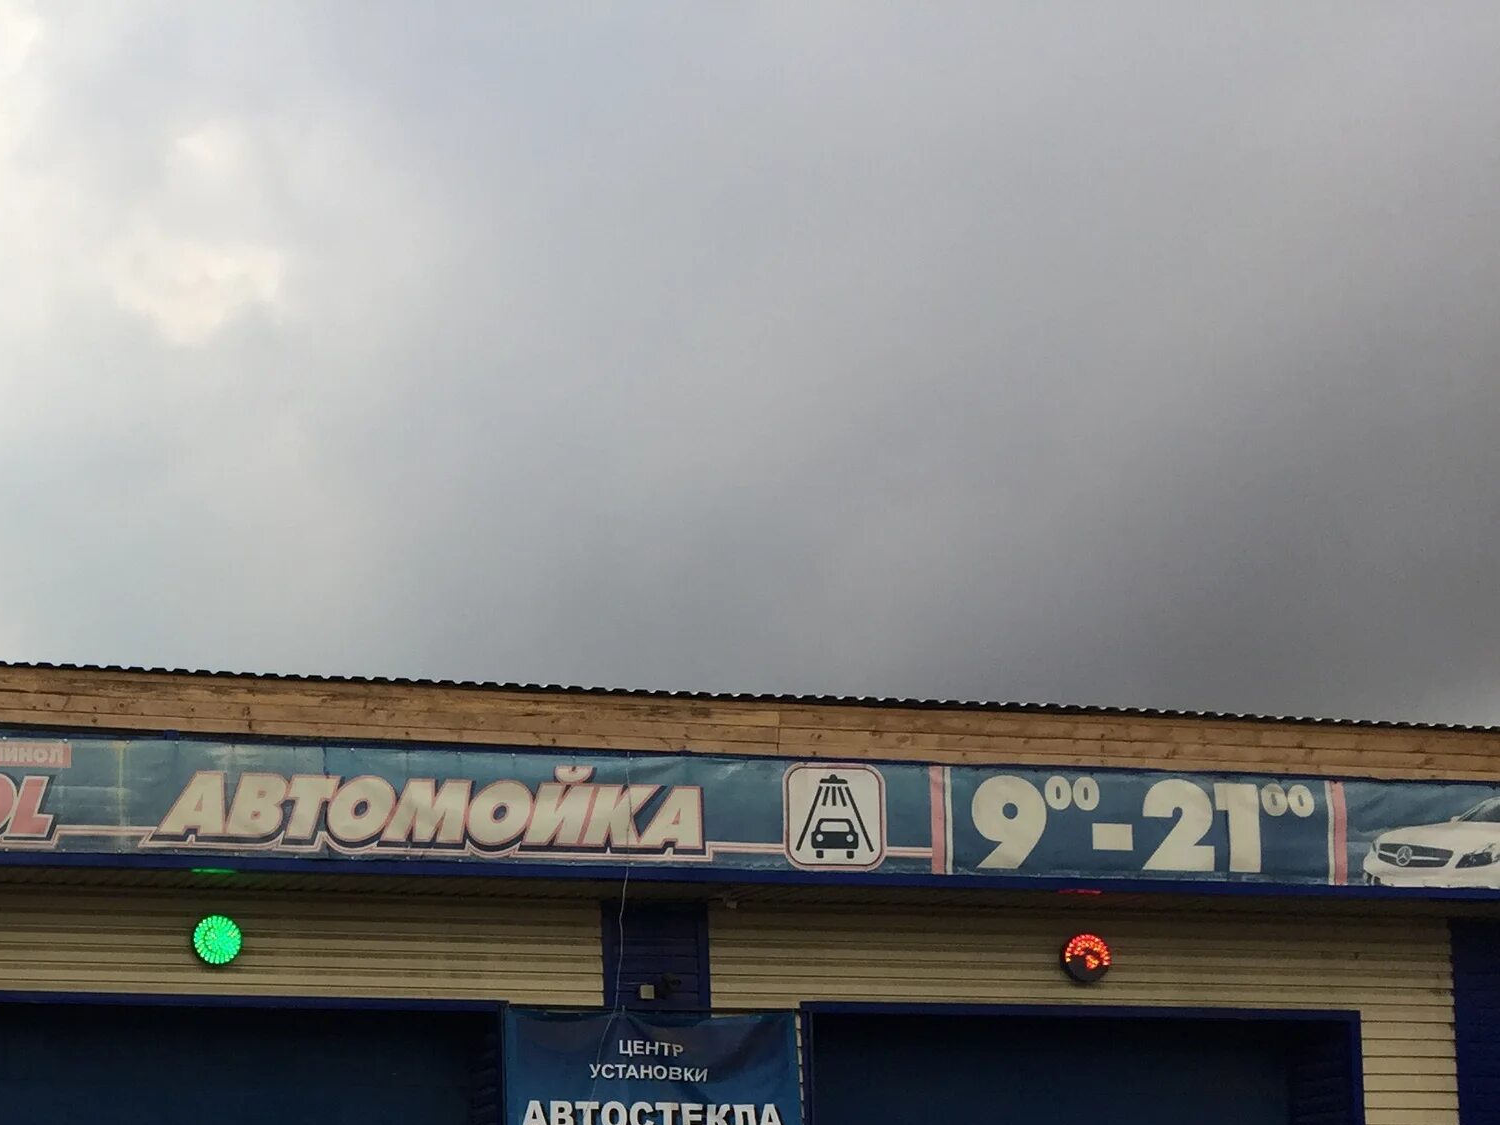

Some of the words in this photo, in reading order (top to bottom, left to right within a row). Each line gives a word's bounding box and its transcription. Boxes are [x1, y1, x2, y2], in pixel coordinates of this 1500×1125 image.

[155, 766, 705, 852] АВТОМОЙКА
[618, 1039, 684, 1057] ЦЕНТР
[589, 1063, 708, 1083] УСТАНОВКИ
